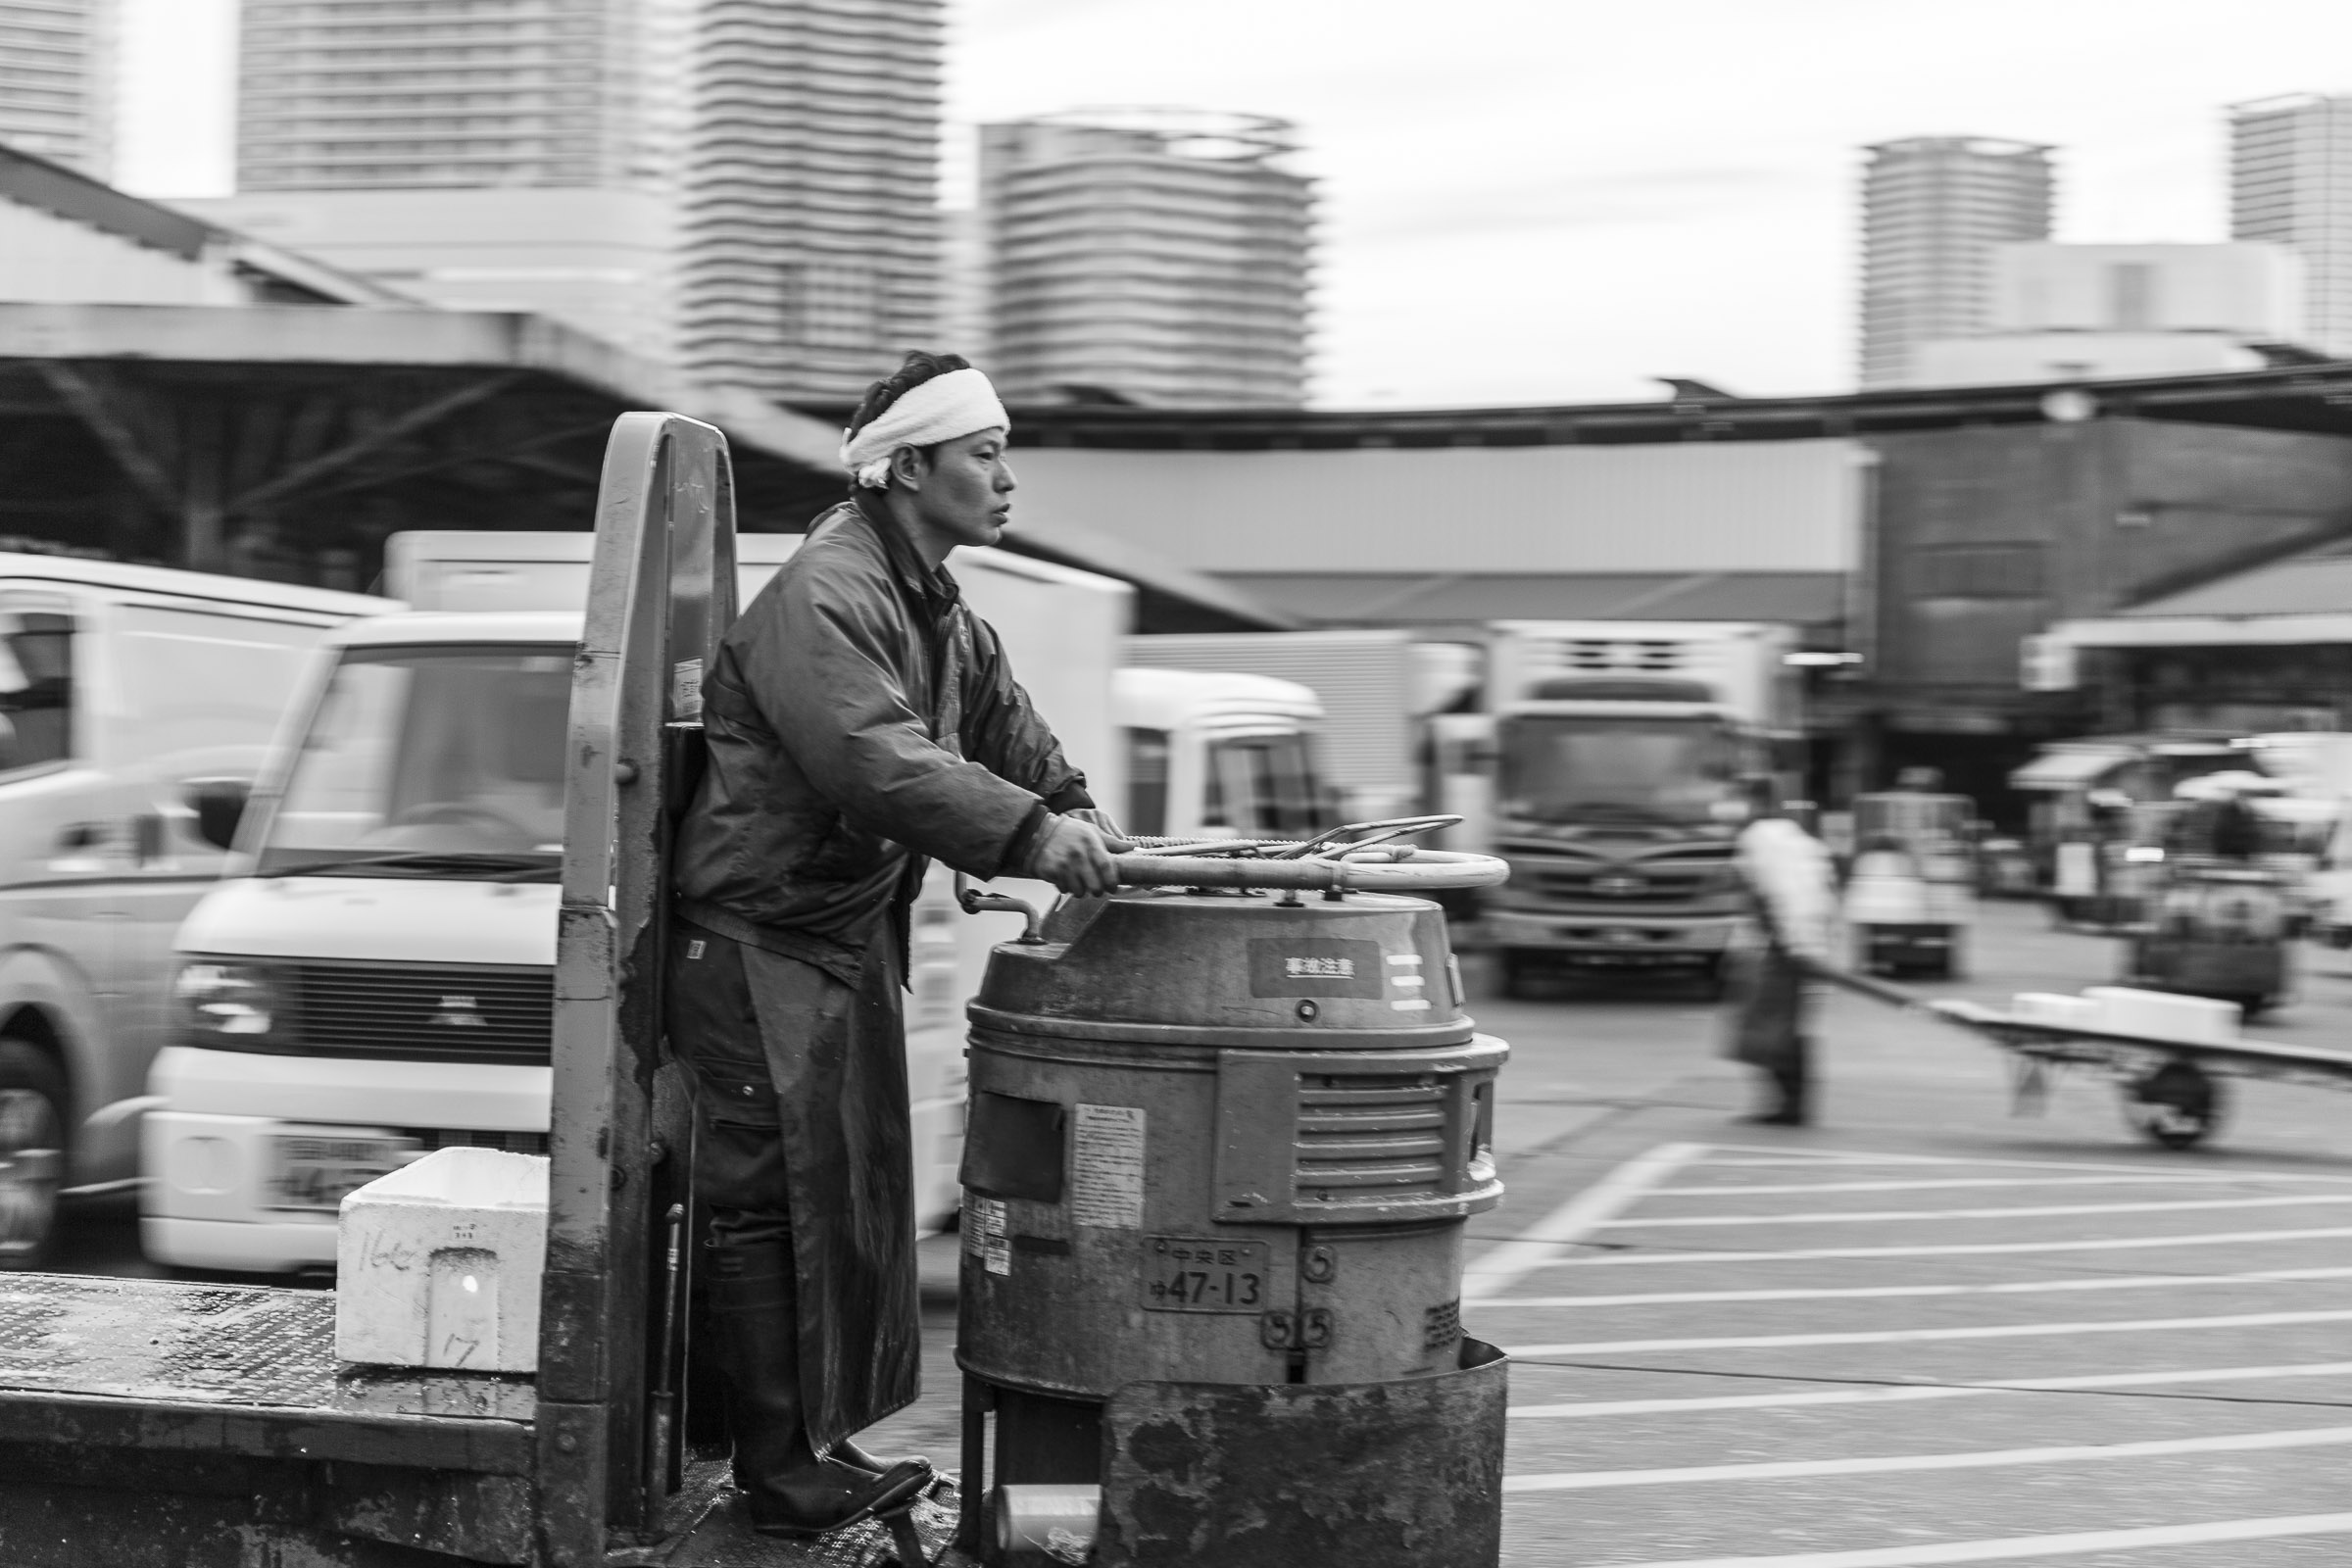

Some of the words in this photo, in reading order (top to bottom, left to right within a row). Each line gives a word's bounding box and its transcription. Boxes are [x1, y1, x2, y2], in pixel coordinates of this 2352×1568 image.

[1171, 1248, 1237, 1267] 中央区
[1167, 1271, 1260, 1304] 47-13
